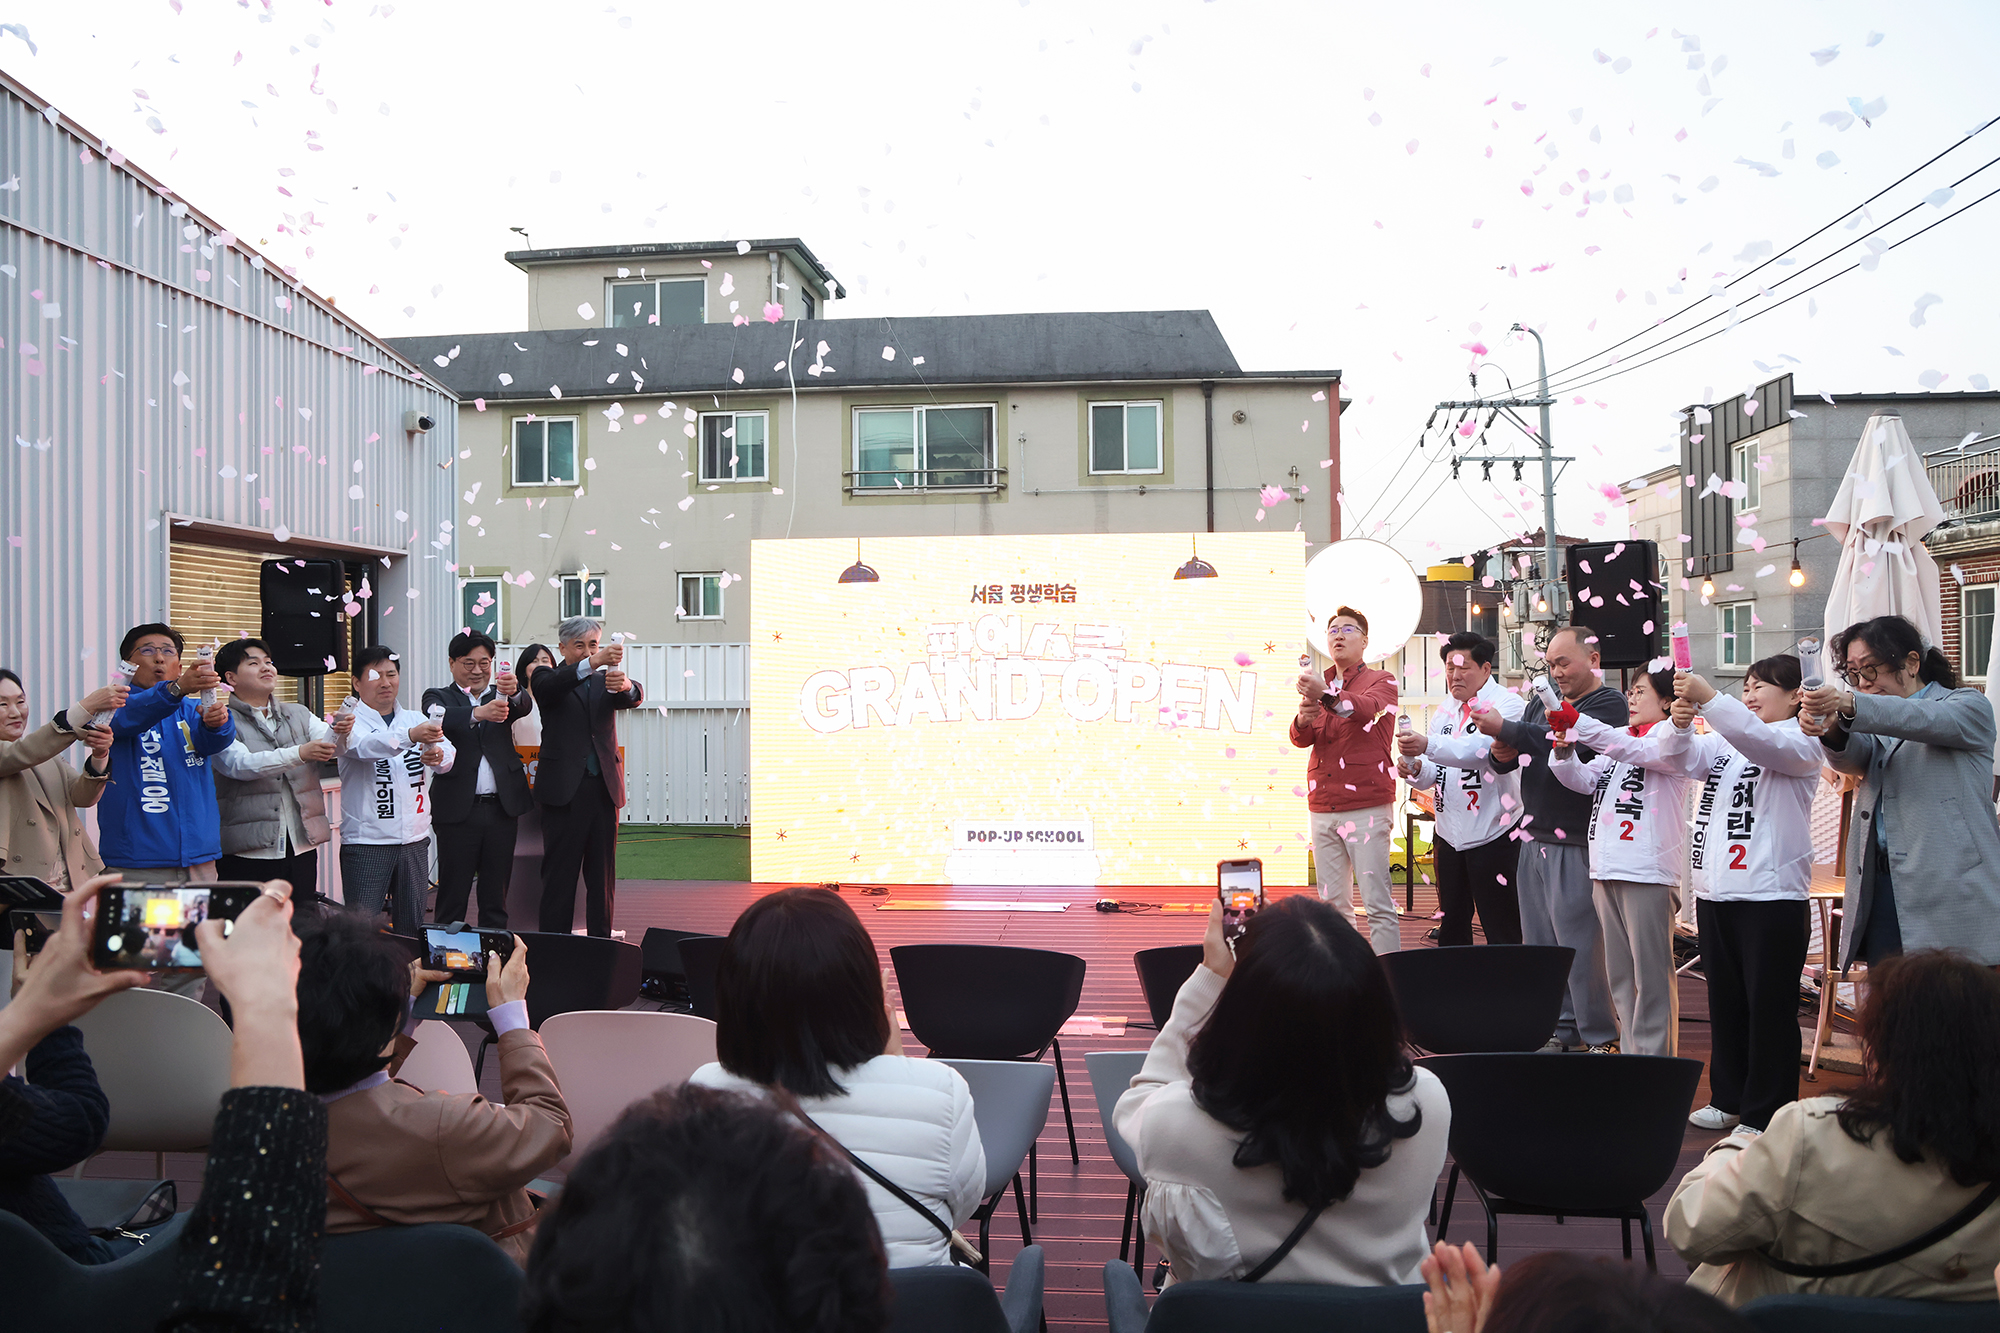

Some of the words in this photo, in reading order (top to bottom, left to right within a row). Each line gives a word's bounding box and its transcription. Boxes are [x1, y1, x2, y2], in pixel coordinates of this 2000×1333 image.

[971, 584, 1003, 604] 서울
[1010, 583, 1077, 603] 평생학습
[800, 657, 1044, 733] GRAND
[1060, 657, 1258, 734] OPEN
[176, 719, 195, 754] 1
[140, 729, 170, 813] 강철웅
[415, 794, 424, 814] 2
[1467, 790, 1480, 811] 2
[967, 830, 1023, 843] POP-UP
[1026, 830, 1085, 843] SCHOOL
[1619, 820, 1634, 841] 2
[1728, 844, 1747, 870] 2
